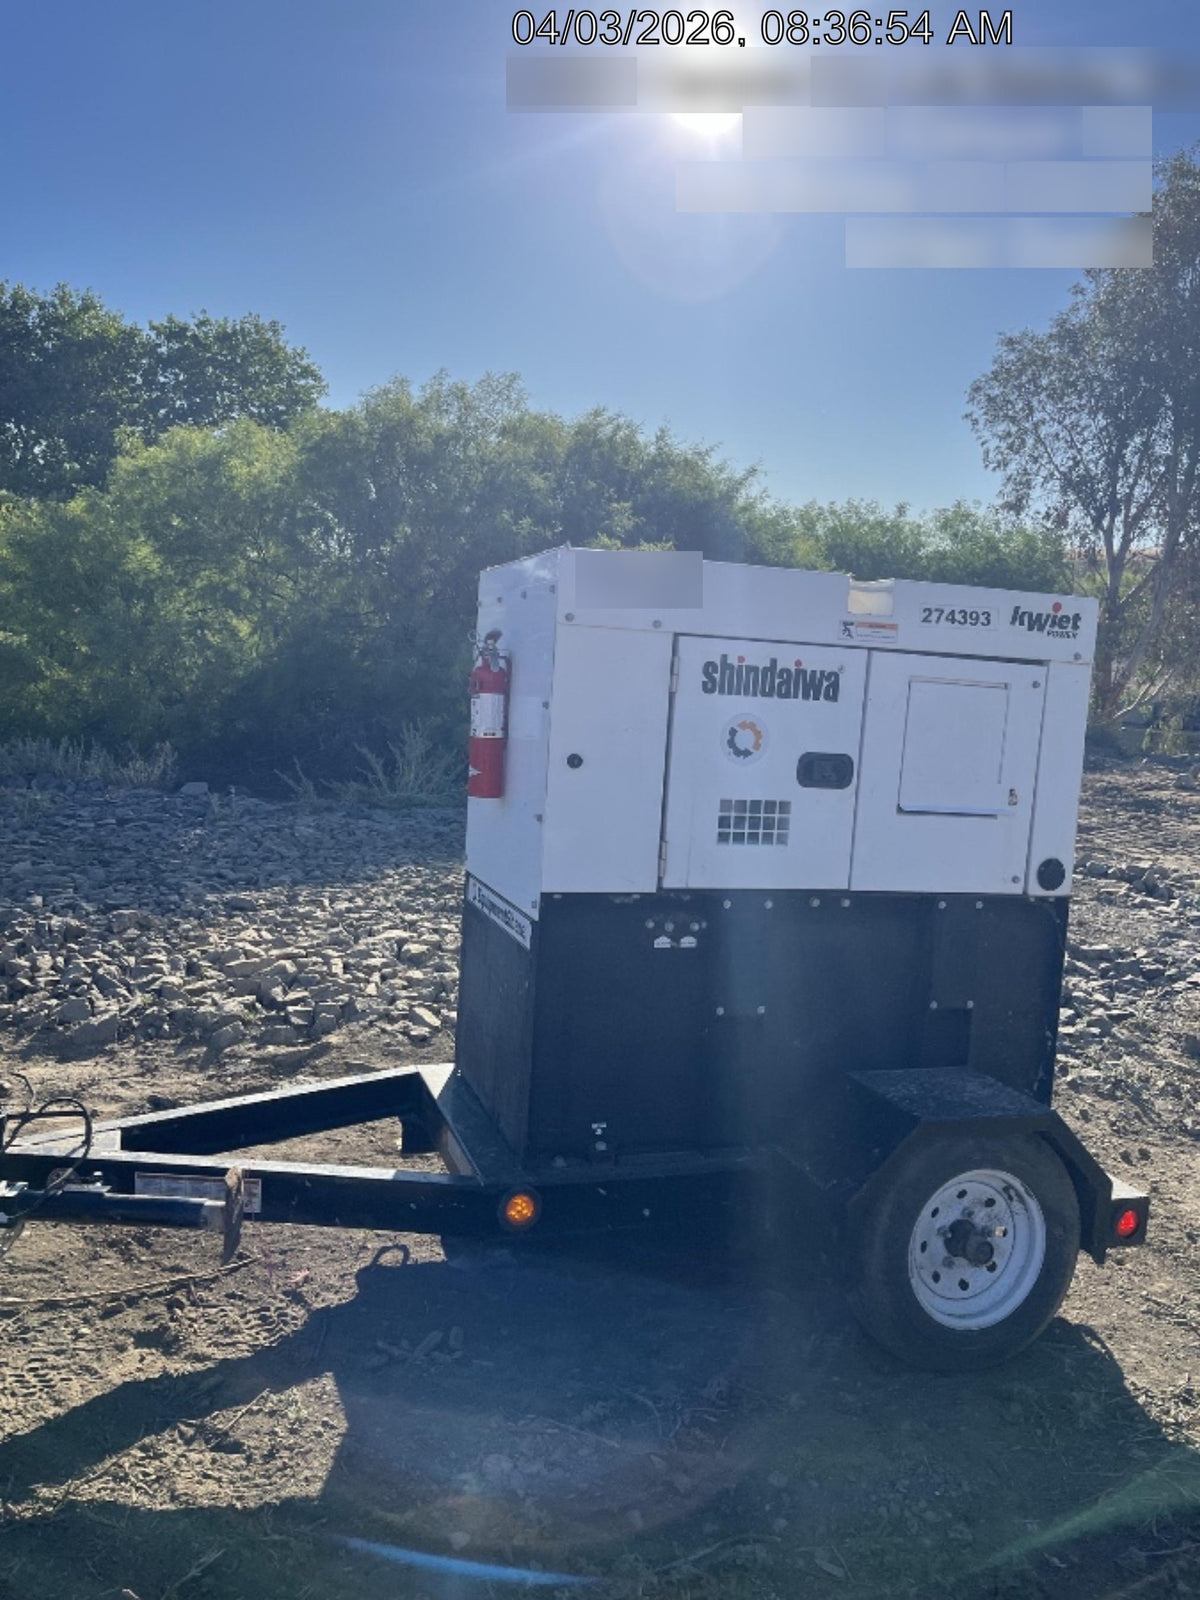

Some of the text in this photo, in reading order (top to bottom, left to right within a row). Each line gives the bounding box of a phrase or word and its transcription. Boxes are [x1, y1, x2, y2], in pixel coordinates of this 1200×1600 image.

[921, 607, 991, 627] 274393
[1010, 602, 1081, 632] kwiet
[702, 653, 840, 703] shindaiwa
